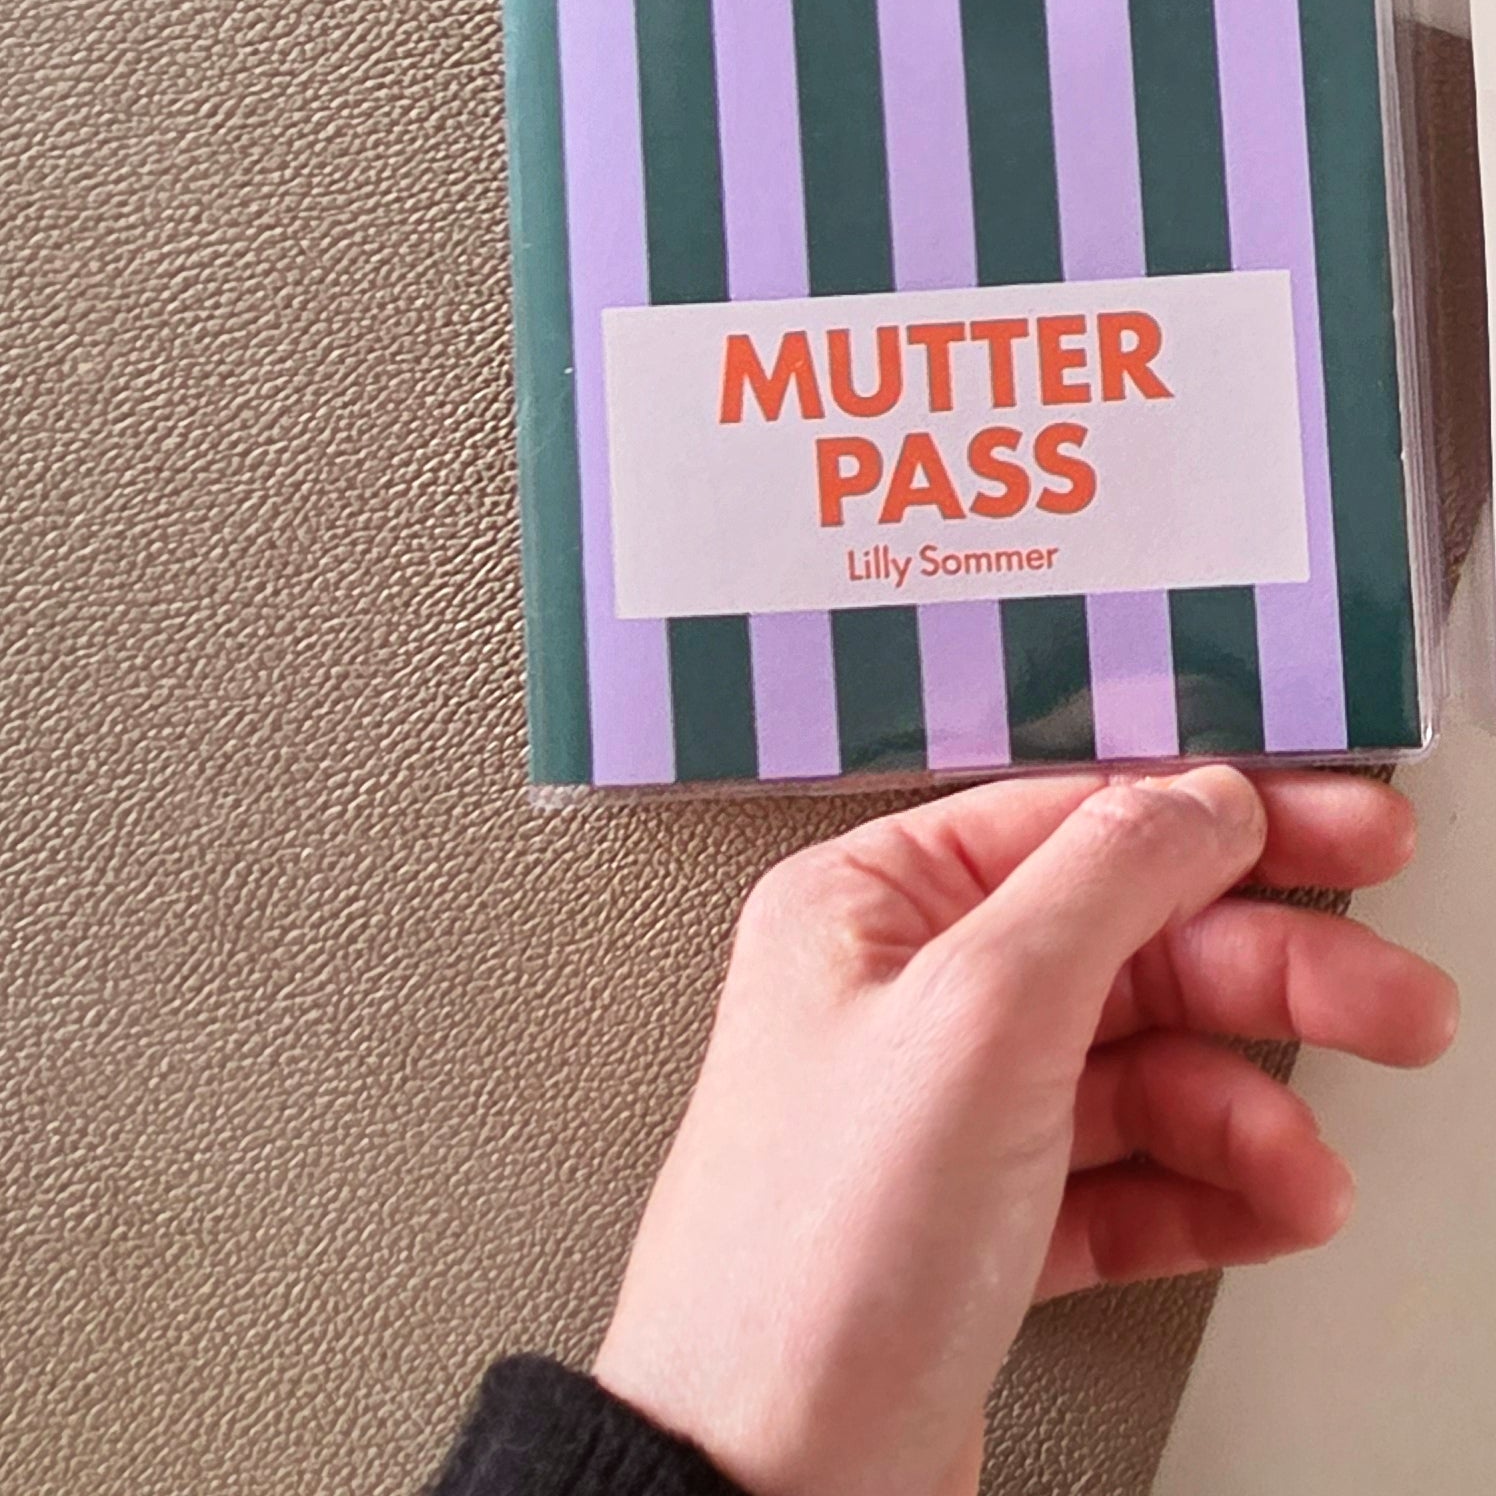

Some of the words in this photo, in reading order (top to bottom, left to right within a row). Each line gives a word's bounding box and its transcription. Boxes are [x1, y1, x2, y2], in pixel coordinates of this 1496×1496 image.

[719, 311, 1175, 424] MUTTER
[815, 422, 1098, 528] PASS
[847, 545, 912, 589] Lilly
[919, 543, 1060, 577] Sommer
